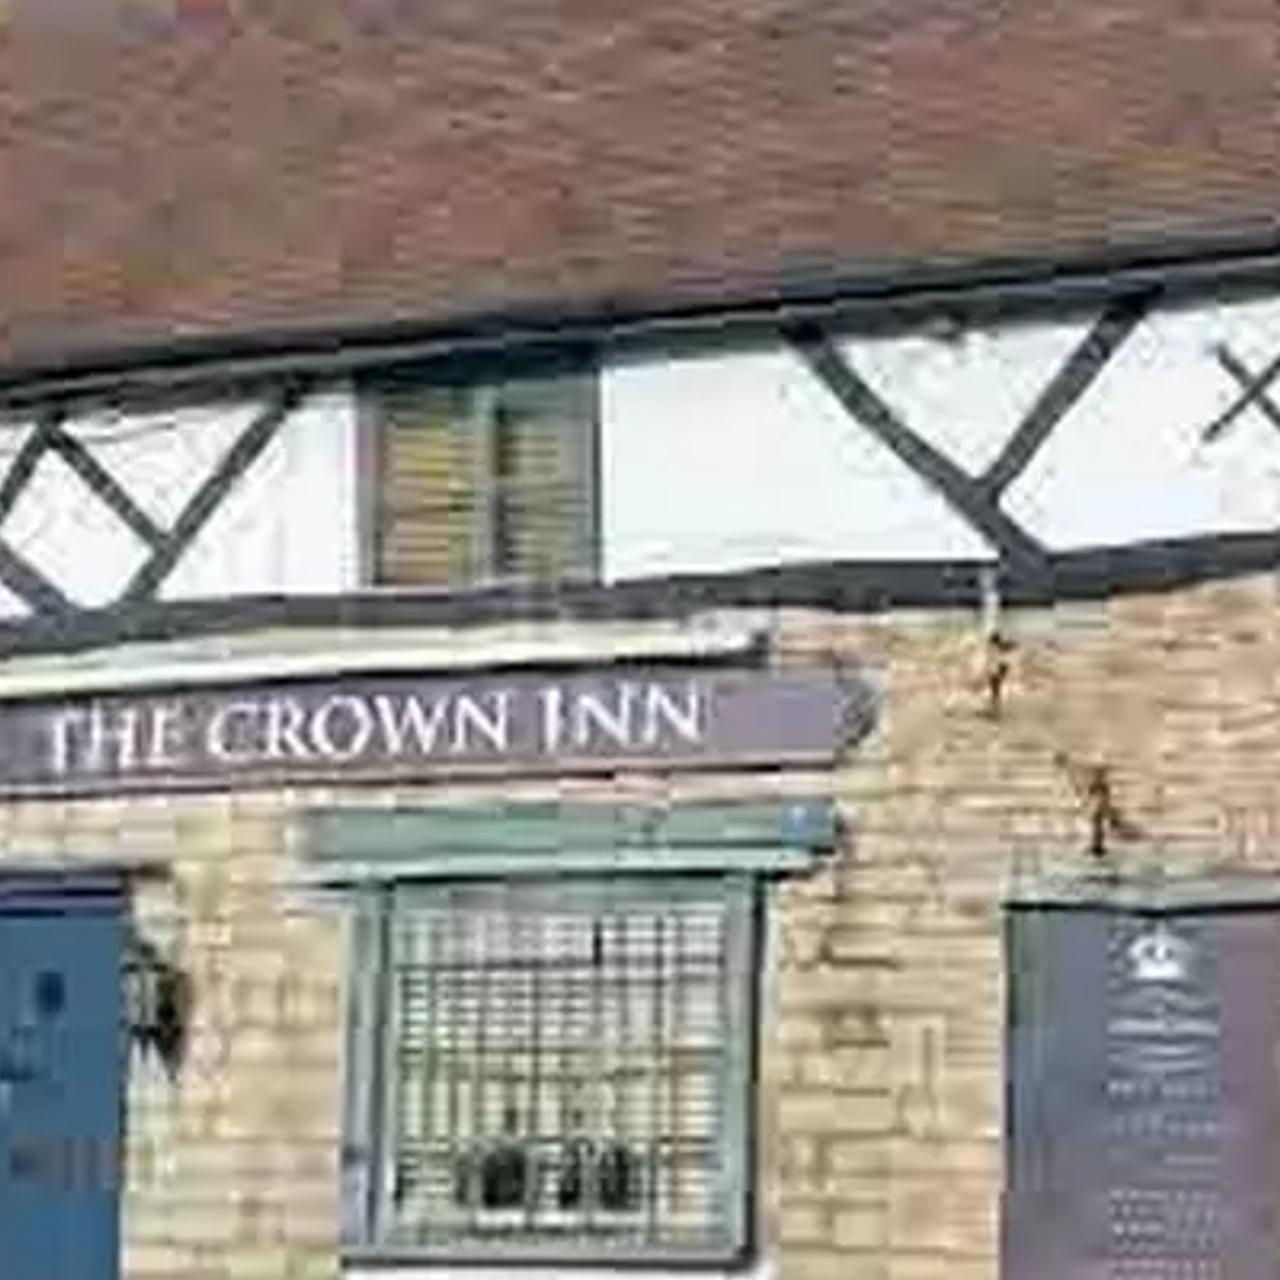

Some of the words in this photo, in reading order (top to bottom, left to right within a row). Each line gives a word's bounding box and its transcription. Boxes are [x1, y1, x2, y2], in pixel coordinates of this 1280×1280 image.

[48, 702, 186, 773] THE
[207, 690, 510, 760] CROWN
[540, 680, 703, 750] INN
